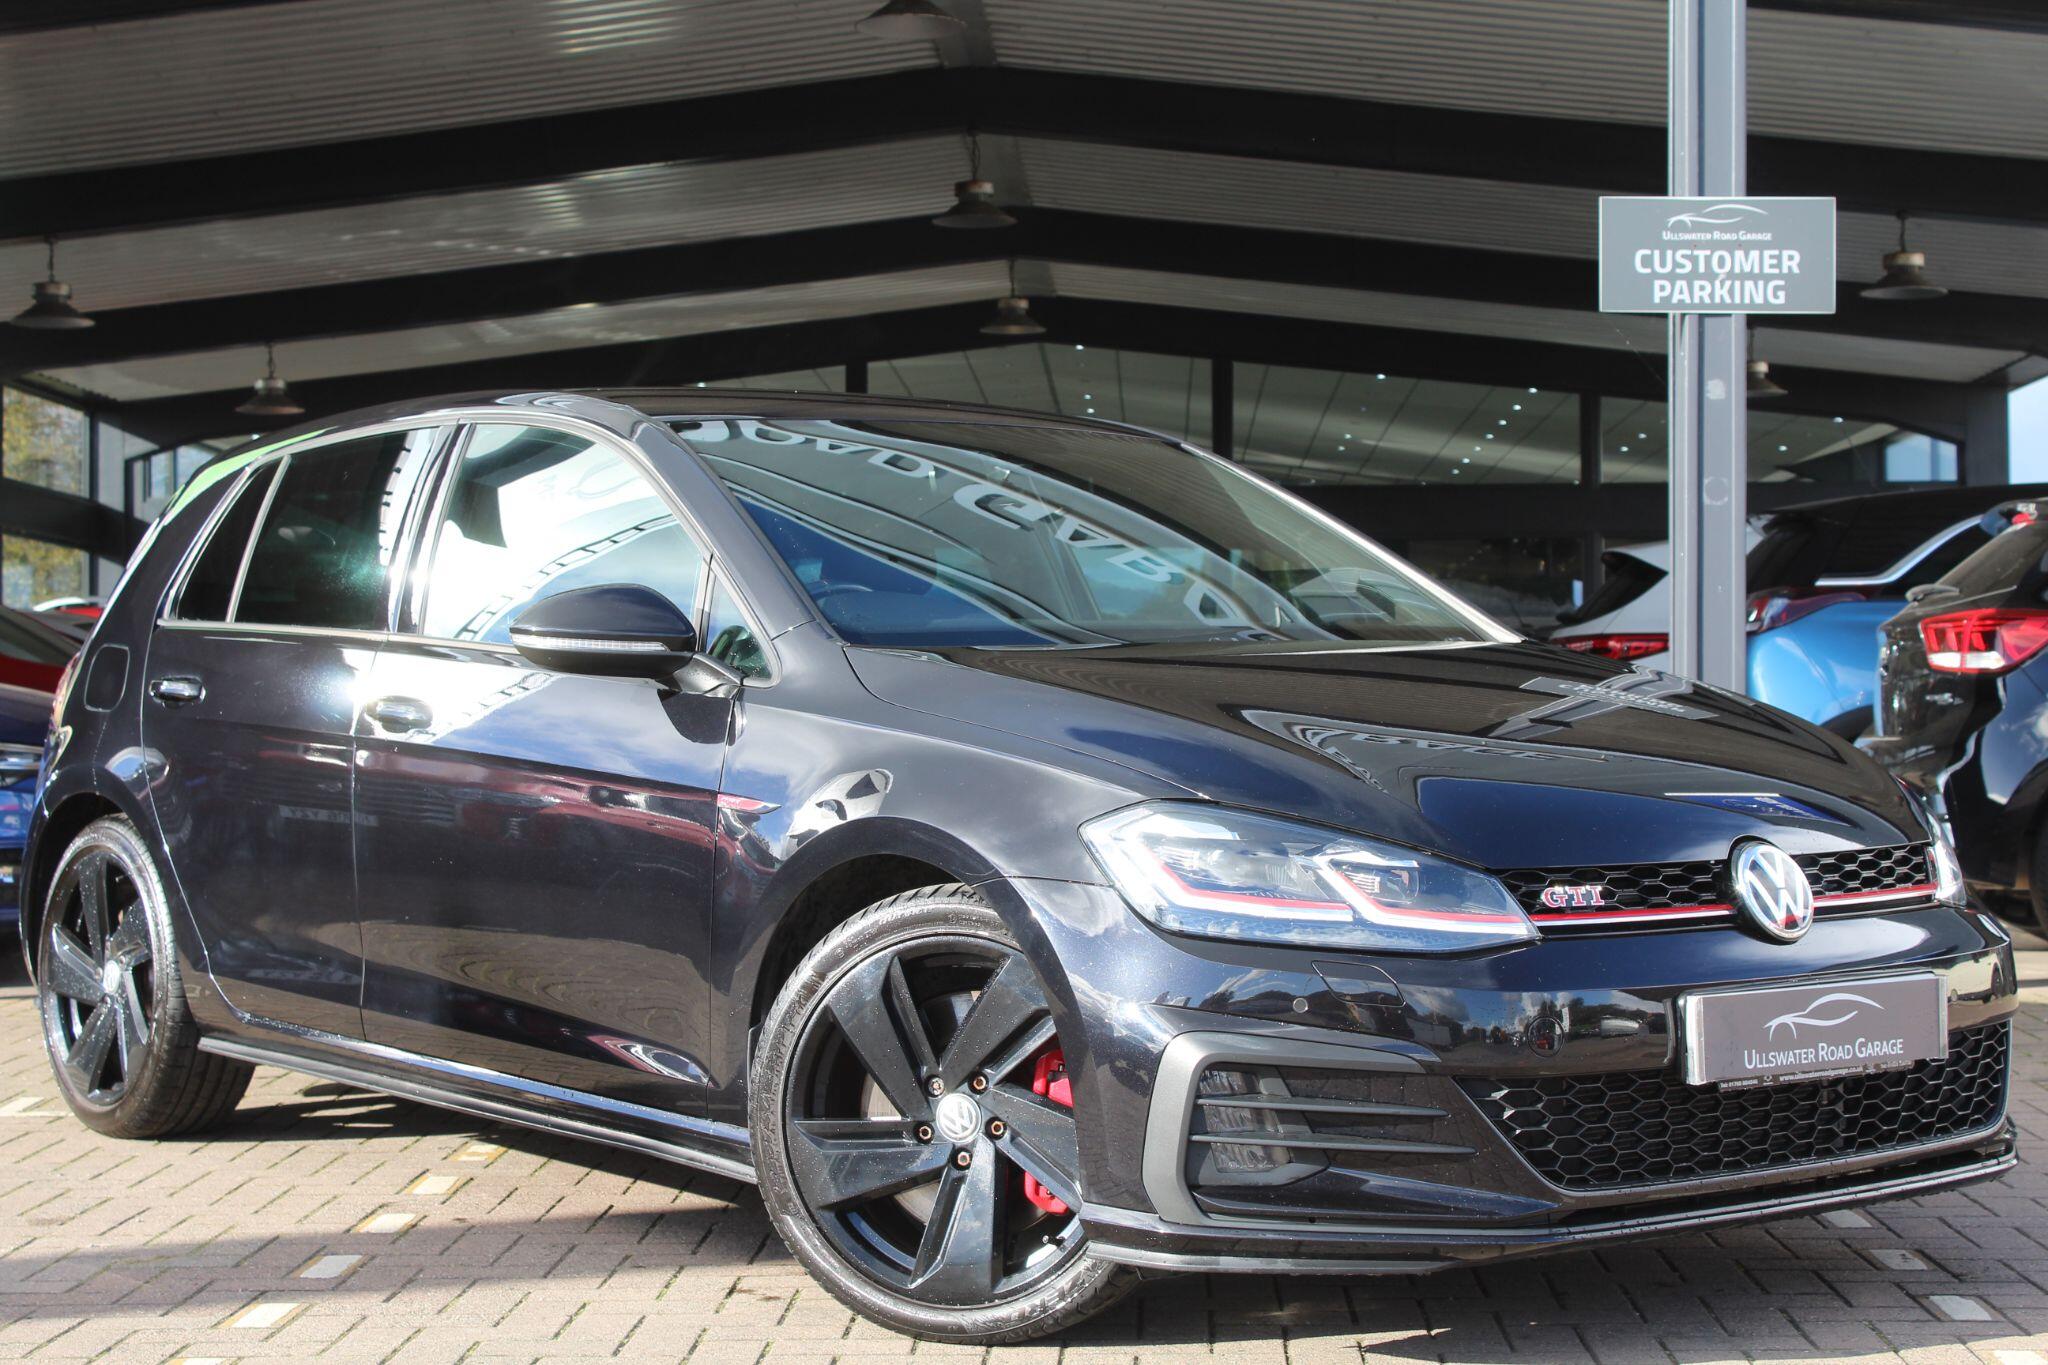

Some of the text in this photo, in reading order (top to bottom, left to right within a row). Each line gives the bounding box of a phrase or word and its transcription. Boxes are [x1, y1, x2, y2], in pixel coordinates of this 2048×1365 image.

[1662, 230, 1772, 241] ULLSWATER ROAD GARAGE
[1634, 248, 1800, 274] CUSTOMER
[1653, 279, 1786, 305] PARKING
[1541, 885, 1605, 908] GTI
[1744, 1037, 1904, 1069] ULLSWATER ROAD GARAGE
